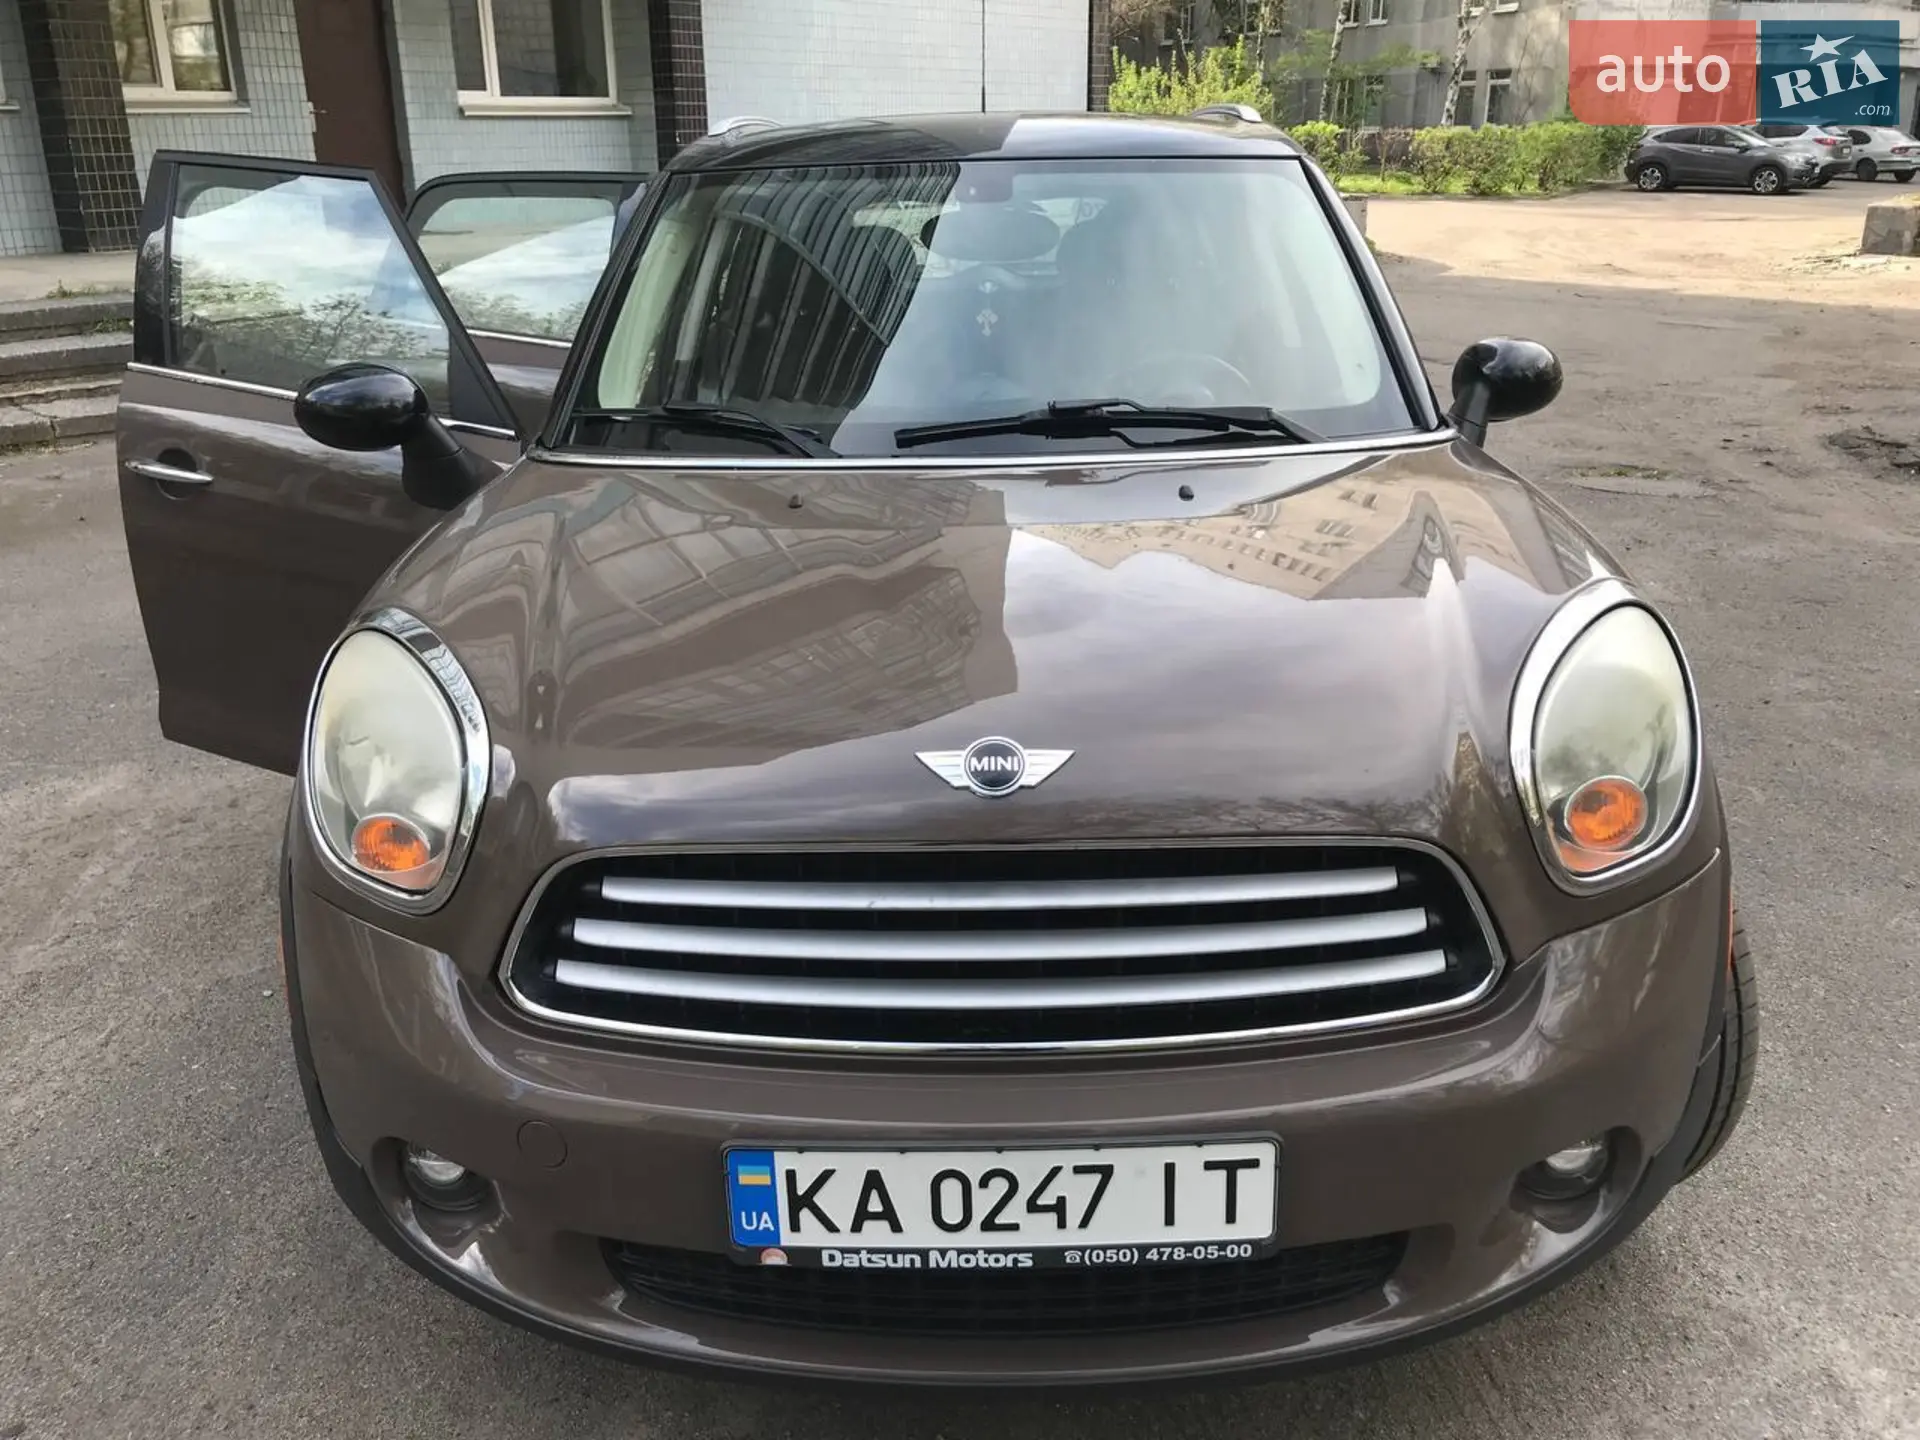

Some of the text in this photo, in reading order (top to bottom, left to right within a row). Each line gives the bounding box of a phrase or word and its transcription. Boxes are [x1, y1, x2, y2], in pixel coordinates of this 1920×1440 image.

[970, 755, 1020, 772] MINI
[785, 1158, 1260, 1233] KA 0247 IT
[741, 1211, 775, 1231] UA
[821, 1249, 1034, 1268] Datsun Motors
[1084, 1244, 1252, 1265] (050) 478-05-00
